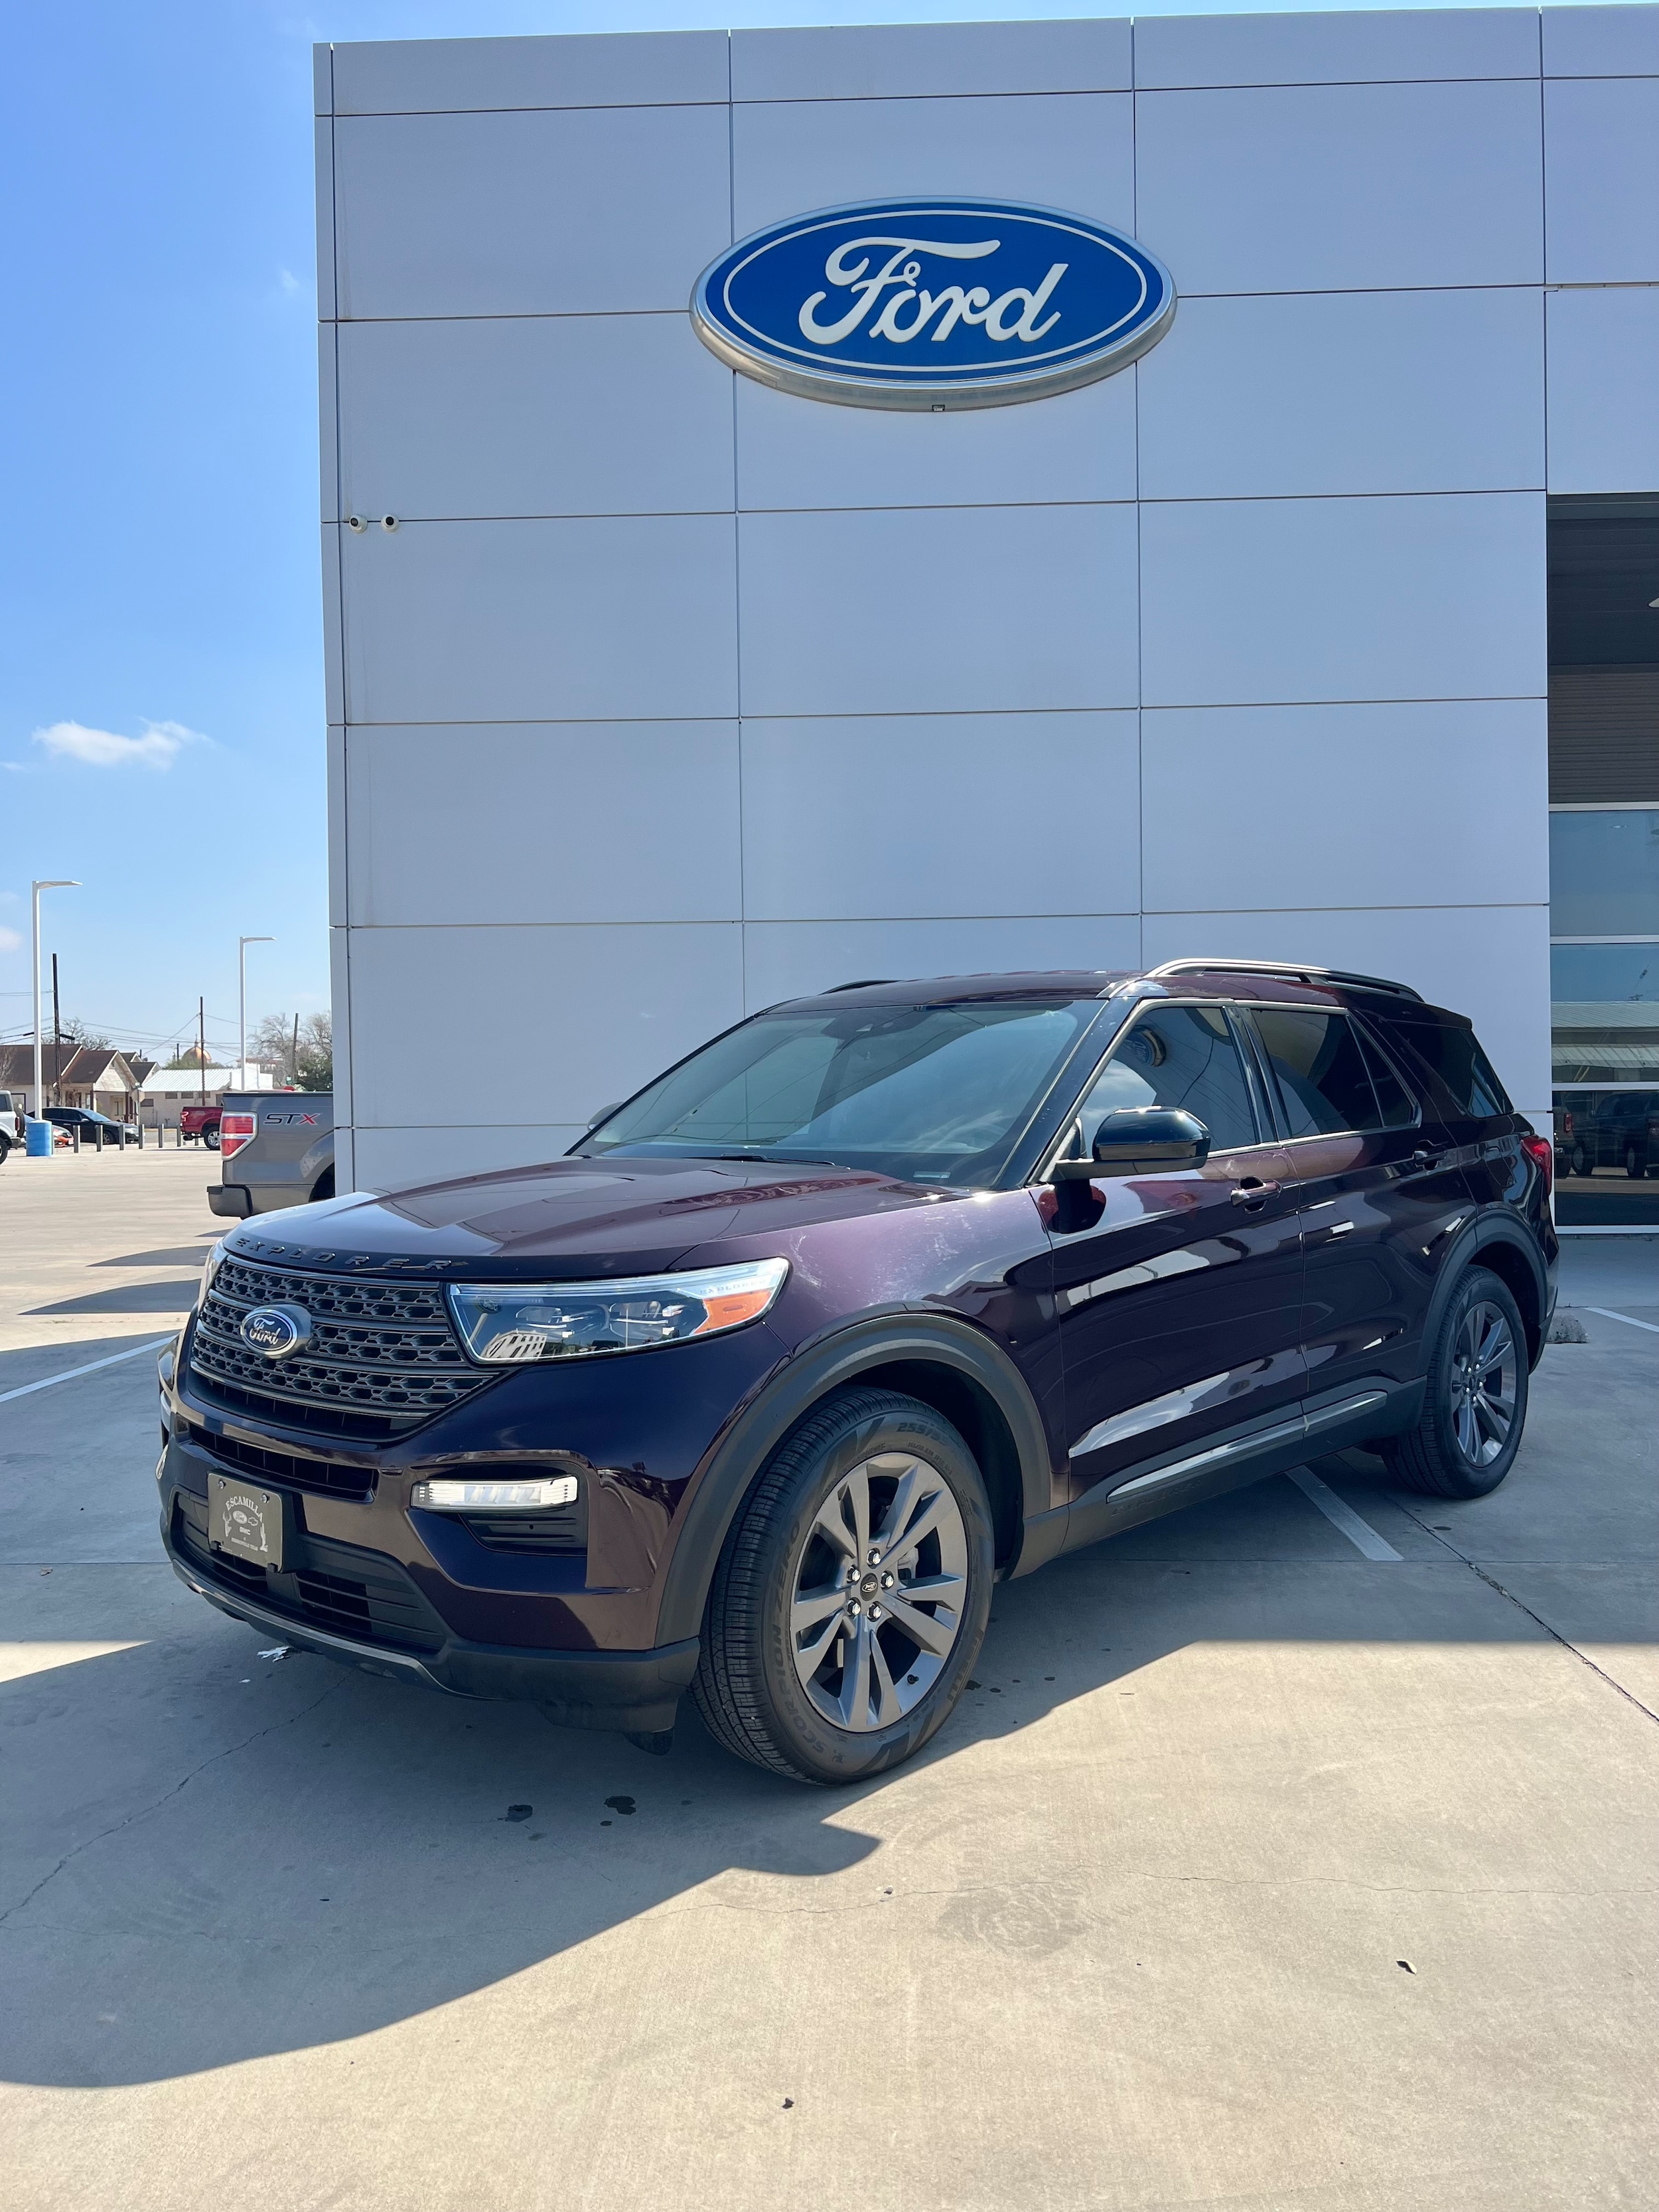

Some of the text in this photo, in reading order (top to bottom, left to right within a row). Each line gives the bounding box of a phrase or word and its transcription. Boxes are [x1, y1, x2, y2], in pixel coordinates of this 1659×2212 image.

[798, 236, 1068, 344] Ford
[263, 1112, 321, 1126] STX
[235, 1237, 453, 1270] EXPLORER
[249, 1317, 281, 1346] Ford
[226, 1496, 263, 1522] ESCAMILLA
[772, 1524, 800, 1613] ZERO
